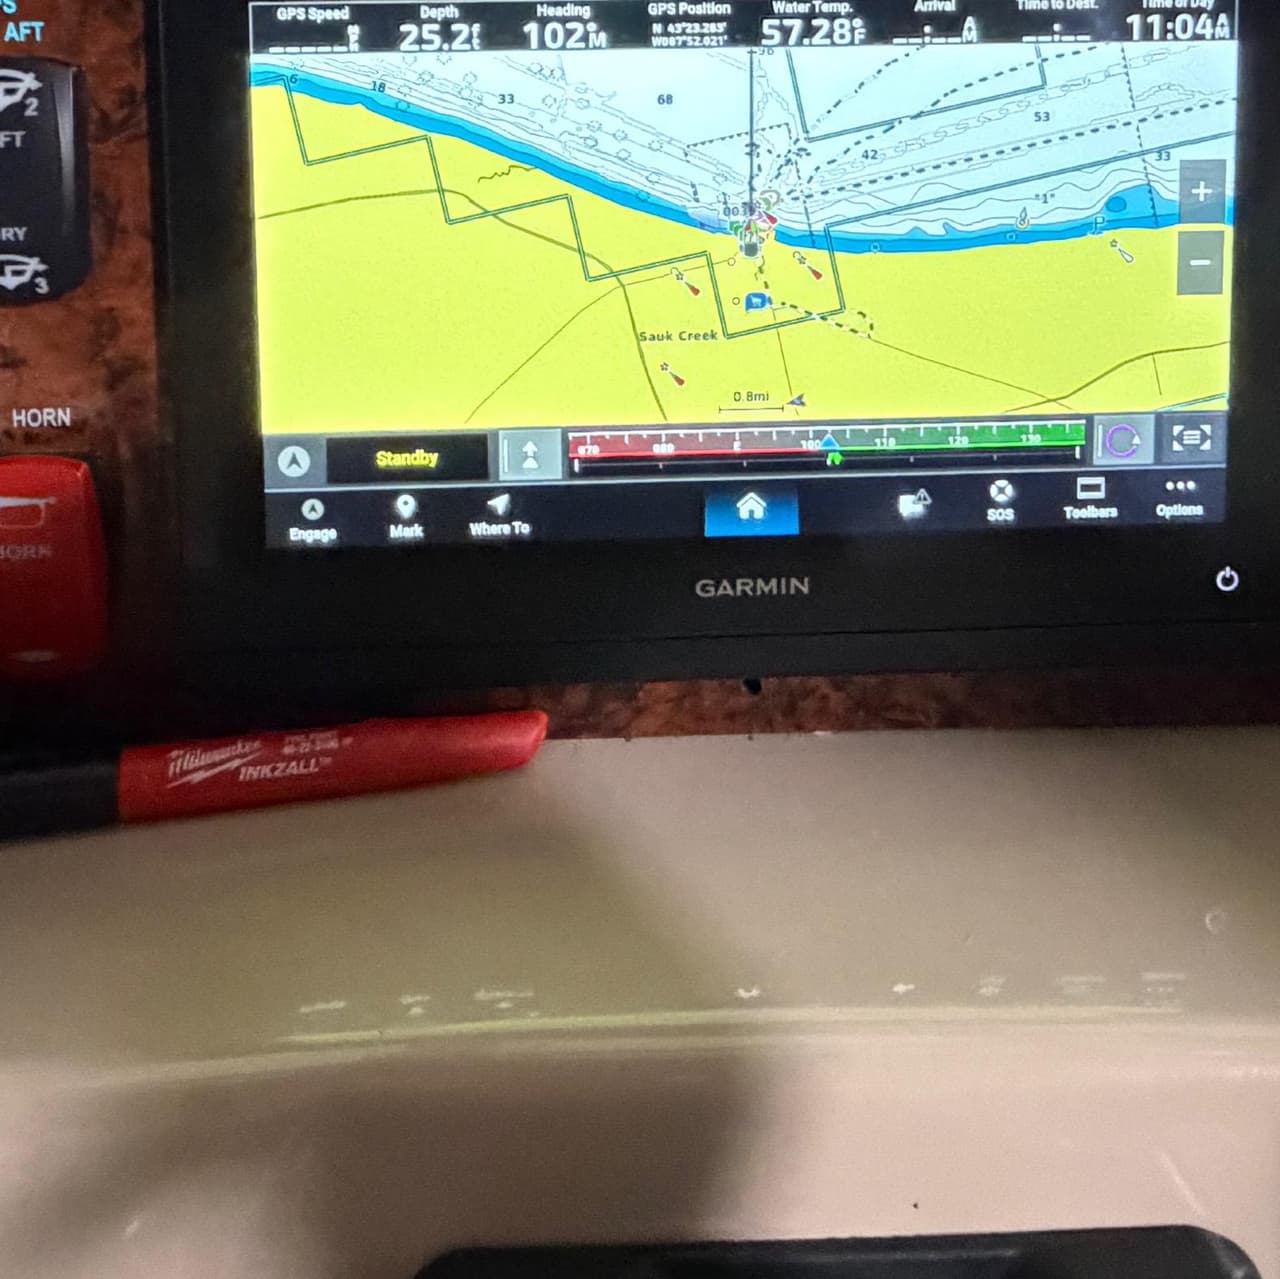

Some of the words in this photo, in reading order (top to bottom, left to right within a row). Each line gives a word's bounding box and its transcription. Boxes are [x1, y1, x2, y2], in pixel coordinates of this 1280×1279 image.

[277, 8, 306, 21] GPS
[308, 6, 350, 23] Speed
[420, 5, 459, 21] Depth
[537, 4, 591, 19] Heading
[648, 2, 676, 15] GPS
[679, 2, 731, 15] Position
[772, 0, 810, 14] Water
[812, 0, 854, 14] Temp.
[4, 21, 45, 43] AFT
[290, 74, 298, 84] 6
[371, 81, 386, 93] 18
[23, 97, 39, 116] 2
[497, 94, 515, 104] 33
[1034, 112, 1050, 122] 53
[861, 149, 878, 161] 42
[1155, 151, 1171, 161] 33
[34, 277, 50, 295] 3
[640, 330, 674, 342] Sauk
[679, 329, 718, 342] Creek
[12, 407, 71, 428] HORN
[800, 438, 820, 449] 100
[375, 449, 439, 469] Standby
[987, 507, 1015, 521] SOS
[1064, 504, 1118, 520] Toolbars
[1156, 502, 1204, 518] Options
[289, 526, 337, 543] Engage
[390, 524, 423, 539] Mark
[469, 521, 510, 537] Where
[513, 520, 530, 535] To
[694, 577, 810, 599] GARMIN
[239, 758, 319, 781] INKZALL
